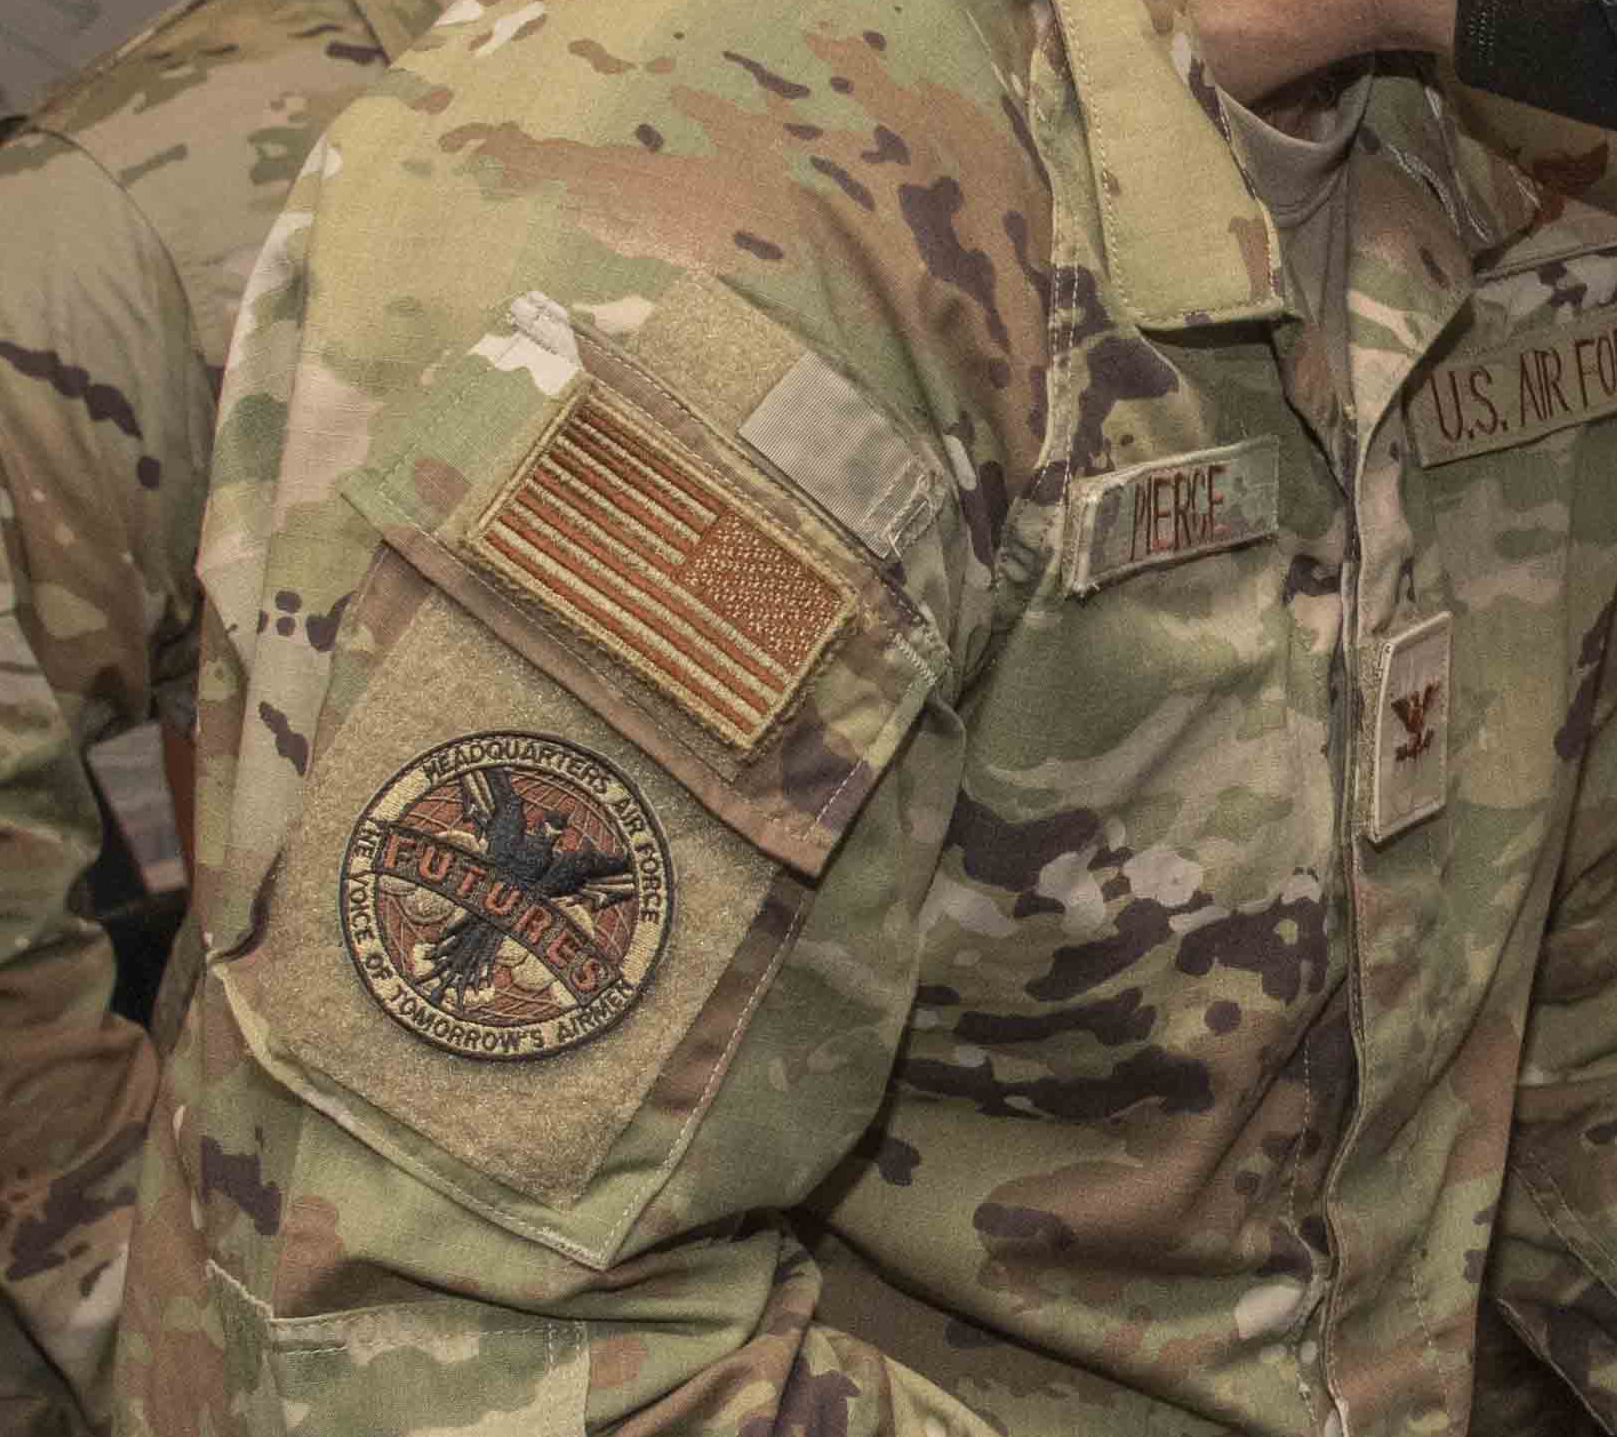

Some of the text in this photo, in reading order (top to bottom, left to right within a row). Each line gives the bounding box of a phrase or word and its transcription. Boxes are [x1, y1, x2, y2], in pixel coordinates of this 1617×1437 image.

[1431, 376, 1510, 442] U.S.
[1519, 349, 1567, 428] AIR
[1128, 465, 1227, 562] PIERCE
[355, 817, 382, 859] THE
[423, 739, 663, 925] HEADQUARTERS AIR FORCE
[348, 871, 376, 945] VOICE
[383, 834, 600, 992] FUTURES
[365, 952, 393, 981] OF
[556, 978, 635, 1044] AIRMEN
